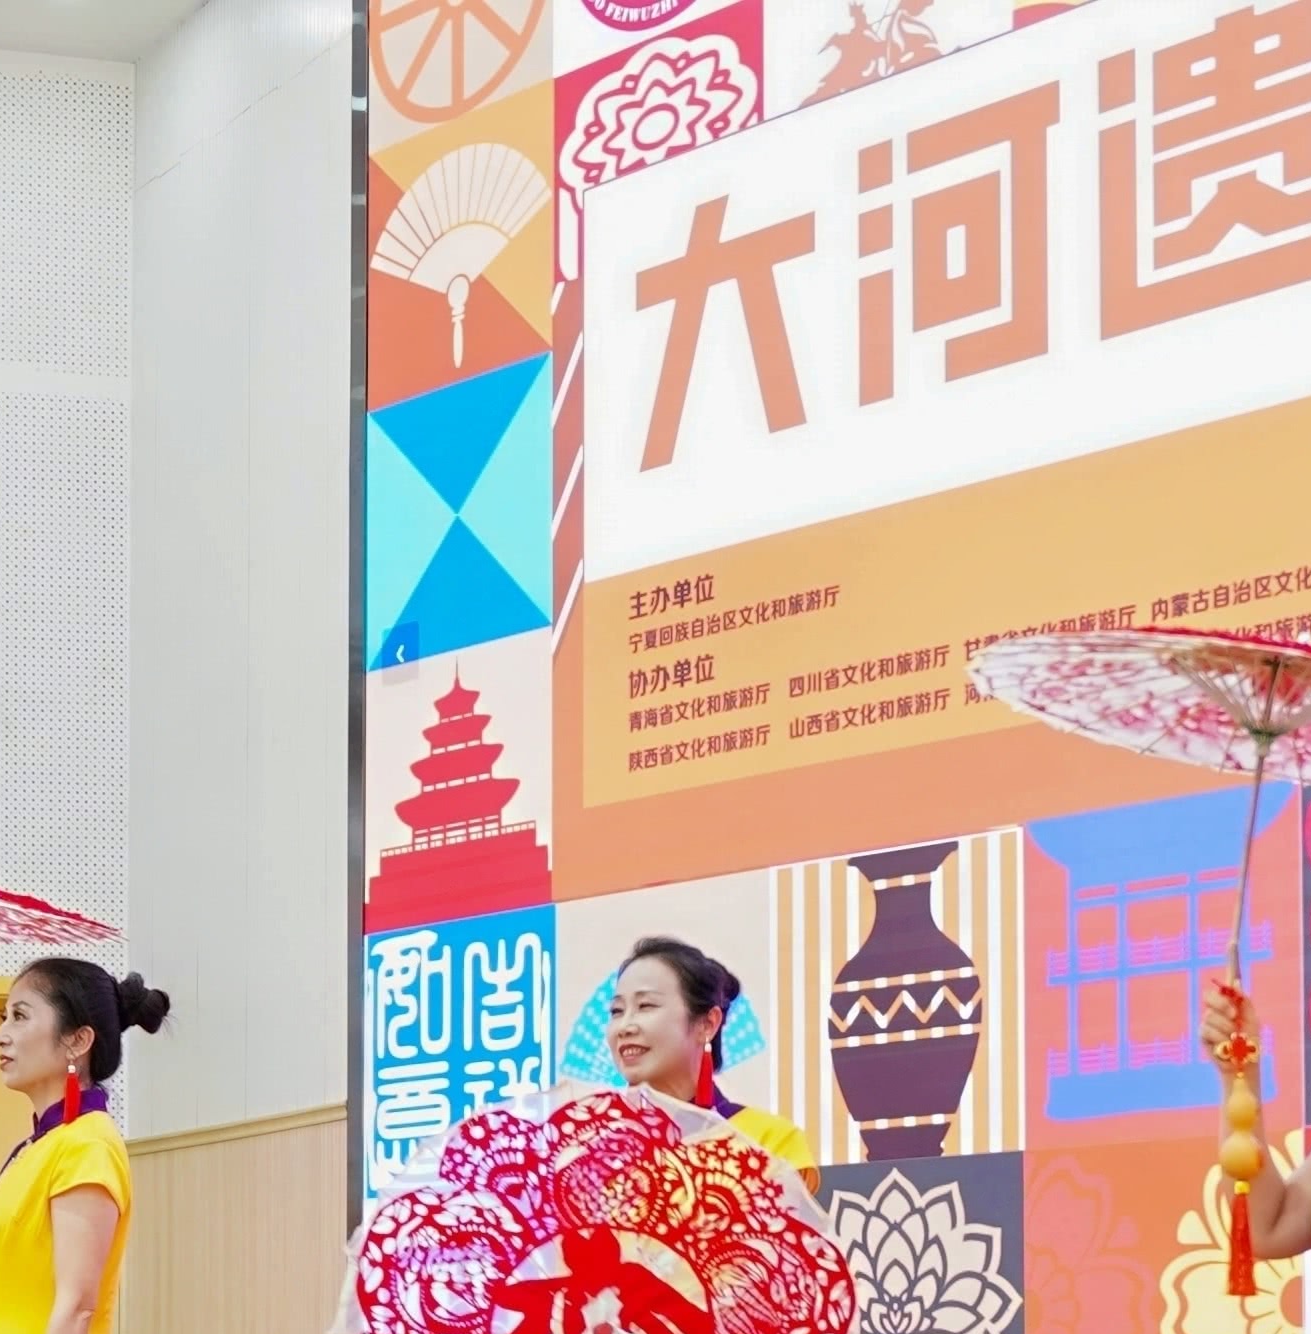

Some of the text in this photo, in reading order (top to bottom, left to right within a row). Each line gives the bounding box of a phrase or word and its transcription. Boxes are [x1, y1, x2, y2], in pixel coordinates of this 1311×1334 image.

[628, 573, 716, 621] 主办单位
[628, 585, 841, 655] 宁夏回族自治区文化和旅游厅
[628, 653, 716, 700] 协办单位
[628, 683, 771, 733] 青海省文化和旅游厅
[788, 644, 951, 699] 四川省文化和旅游厅
[628, 724, 771, 774] 陕西省文化和旅游厅
[788, 688, 952, 740] 山西省文化和旅游厅
